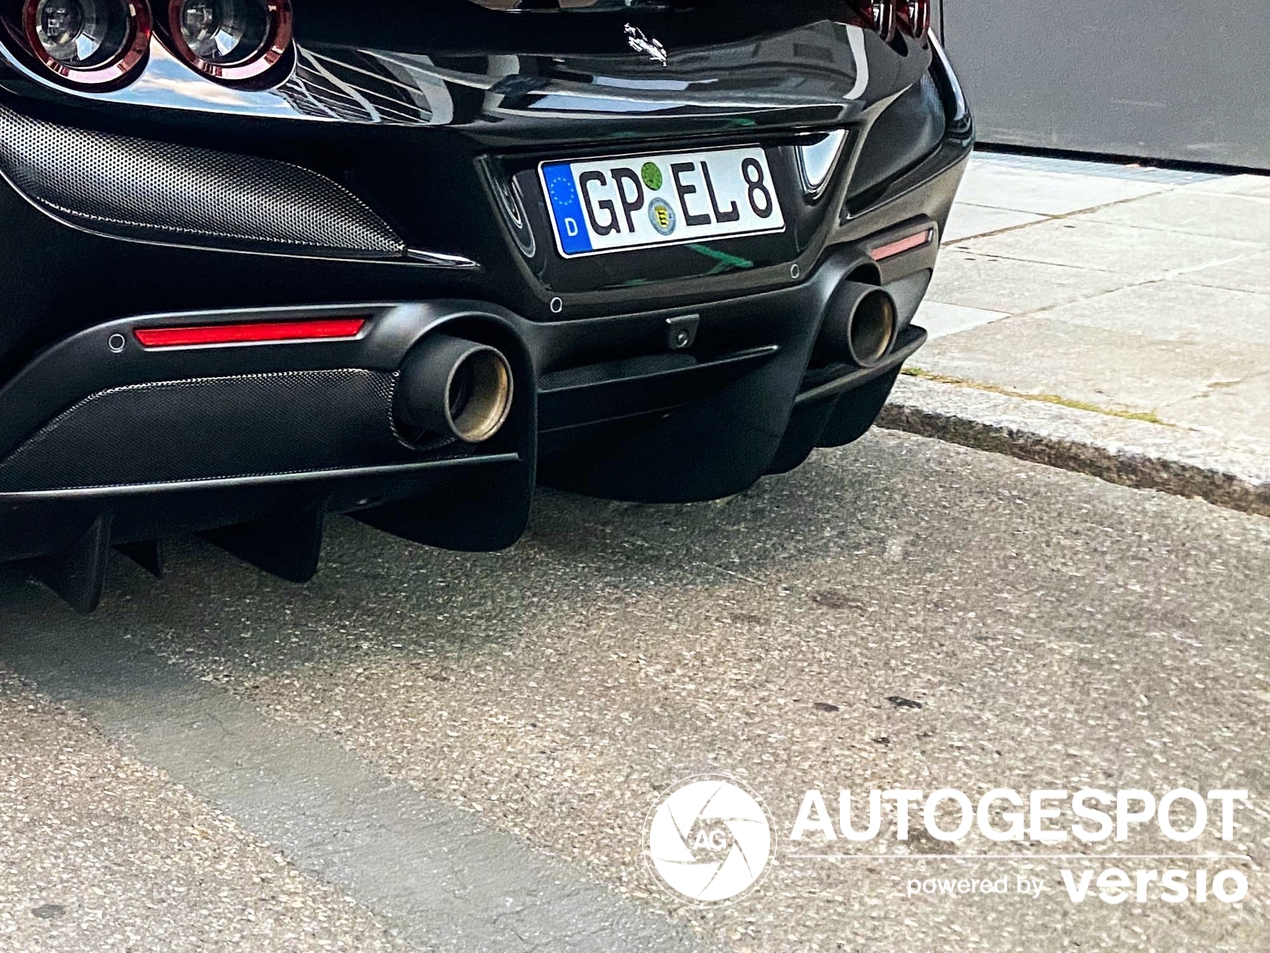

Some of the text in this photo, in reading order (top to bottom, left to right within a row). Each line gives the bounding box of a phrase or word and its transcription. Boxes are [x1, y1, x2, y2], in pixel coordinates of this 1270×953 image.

[578, 157, 773, 236] GP EL 8
[564, 217, 579, 237] D
